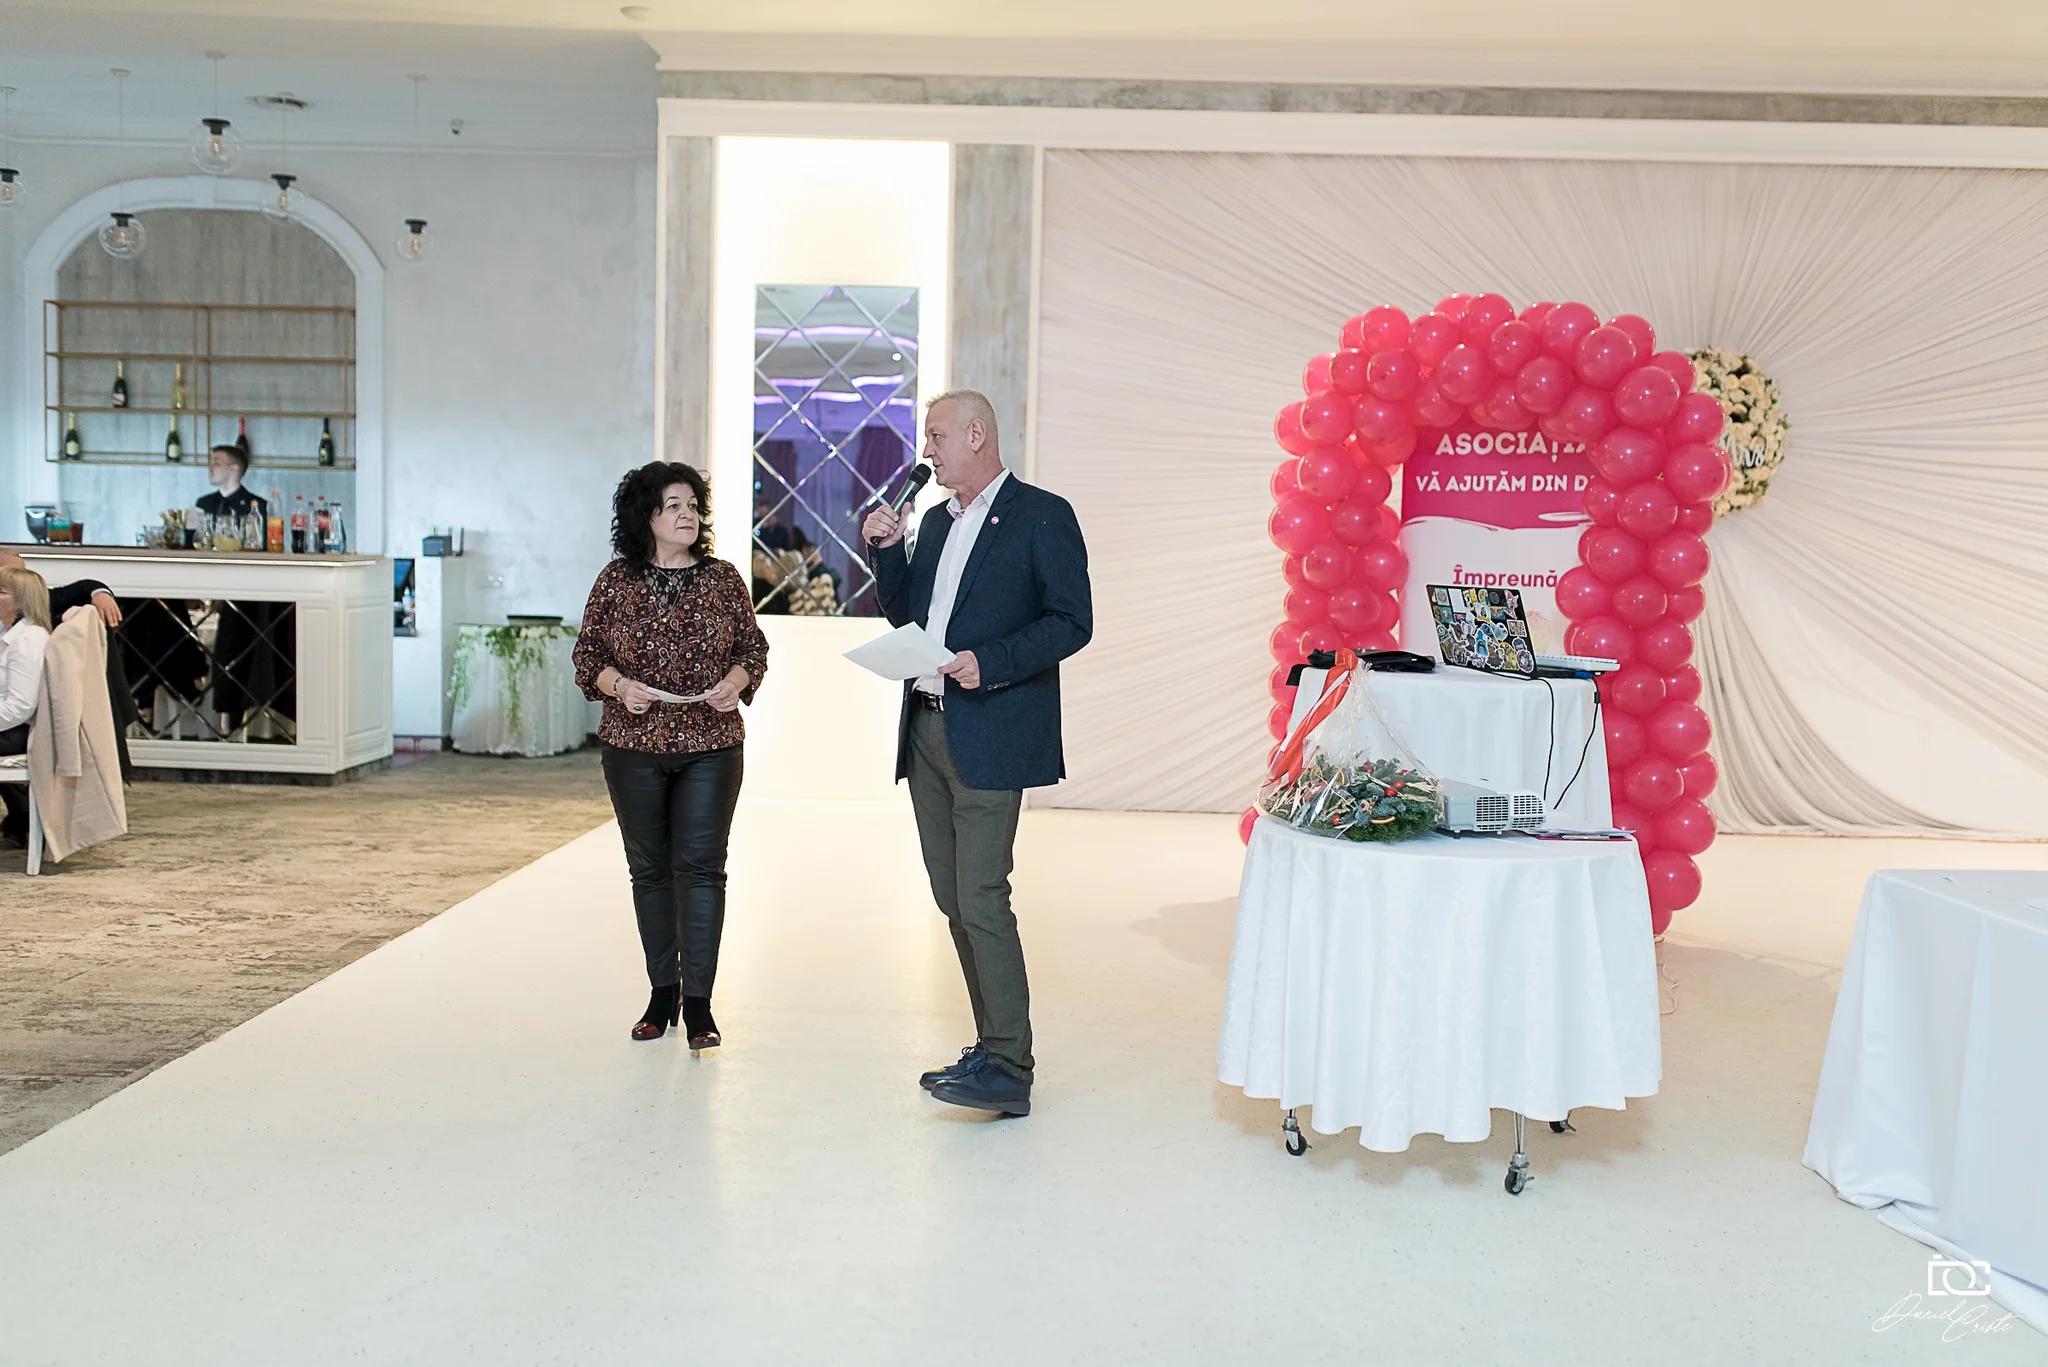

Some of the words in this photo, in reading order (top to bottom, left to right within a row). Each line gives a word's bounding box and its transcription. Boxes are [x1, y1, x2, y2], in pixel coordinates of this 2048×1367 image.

[1435, 432, 1586, 464] ASOCIA
[1416, 470, 1441, 492] VĂ
[1445, 470, 1526, 492] AJUTĂM
[1532, 474, 1568, 491] DIN
[1452, 564, 1558, 588] Împreună
